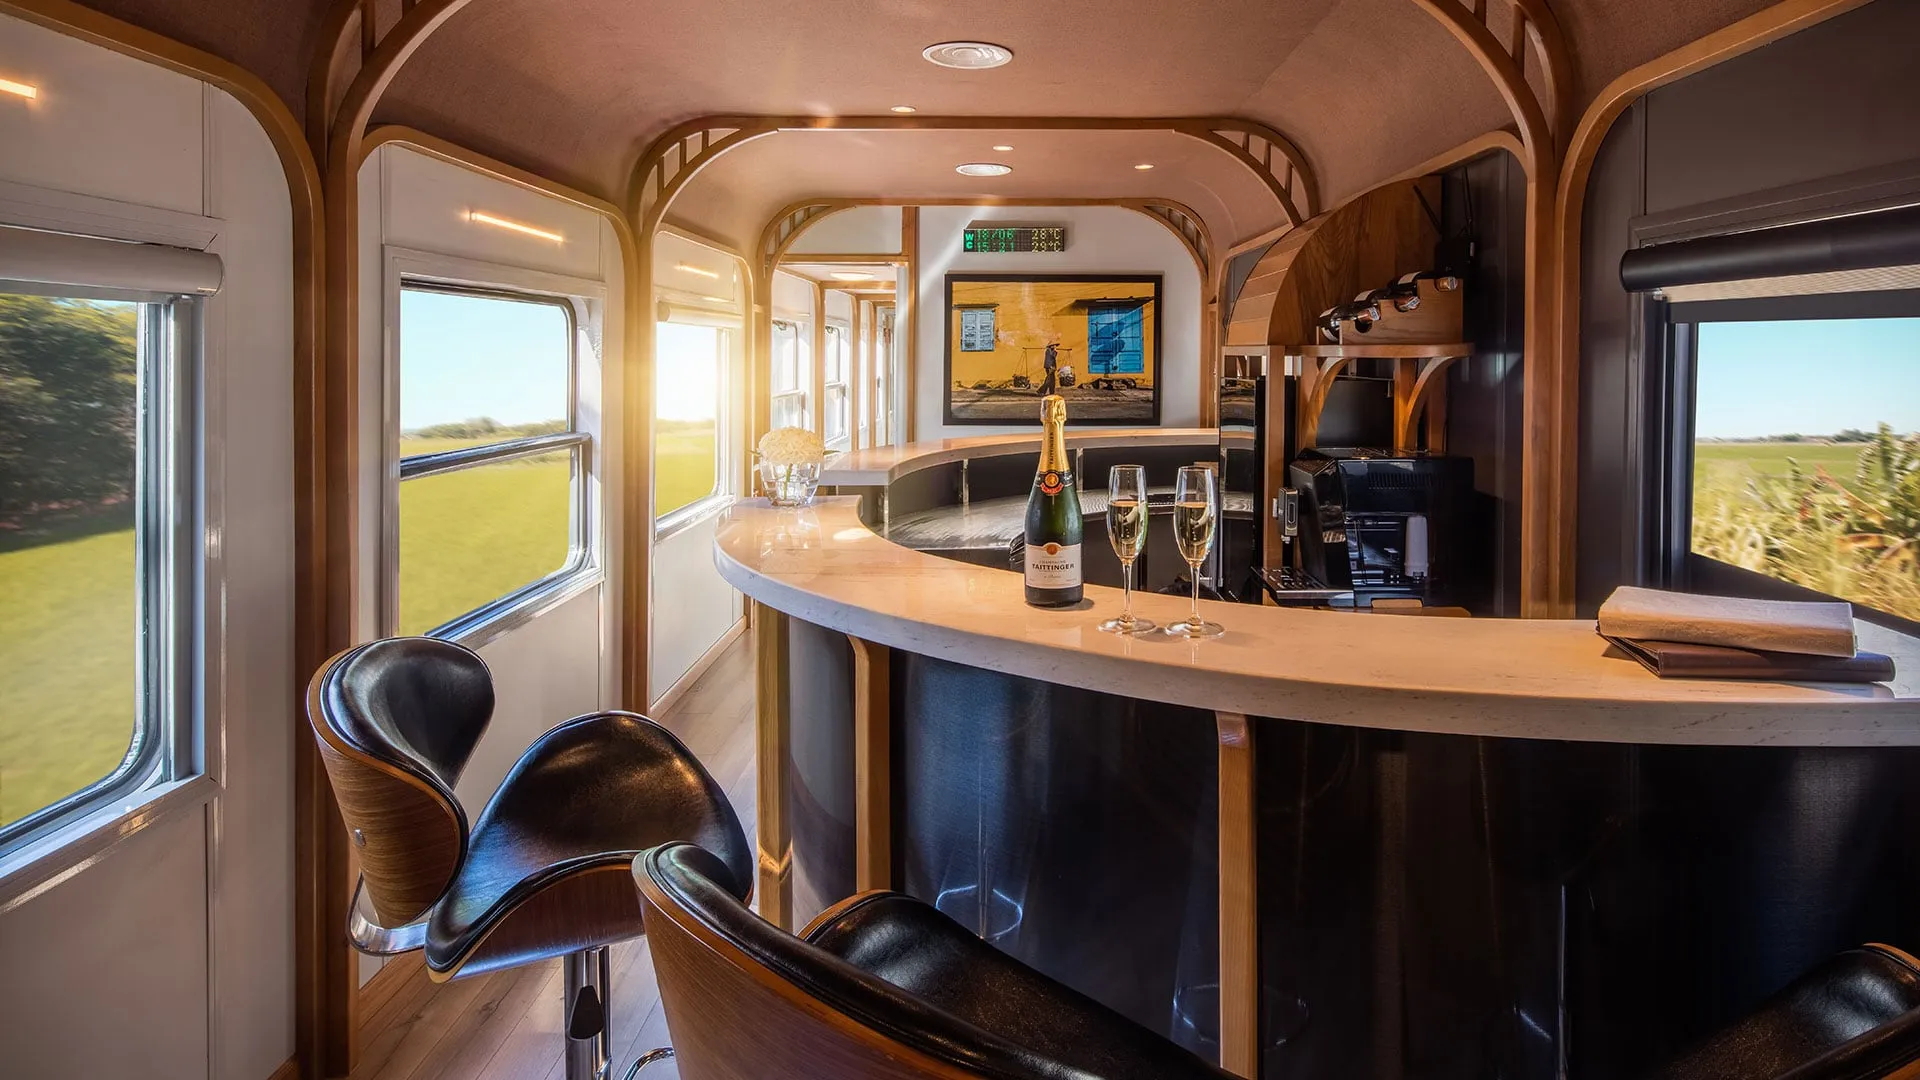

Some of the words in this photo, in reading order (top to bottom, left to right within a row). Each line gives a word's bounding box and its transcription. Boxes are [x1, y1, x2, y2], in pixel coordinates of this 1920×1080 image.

[976, 228, 1014, 240] 18/06
[1032, 228, 1061, 240] 28°C
[976, 241, 1015, 252] 15:21
[1032, 241, 1061, 252] 29°C
